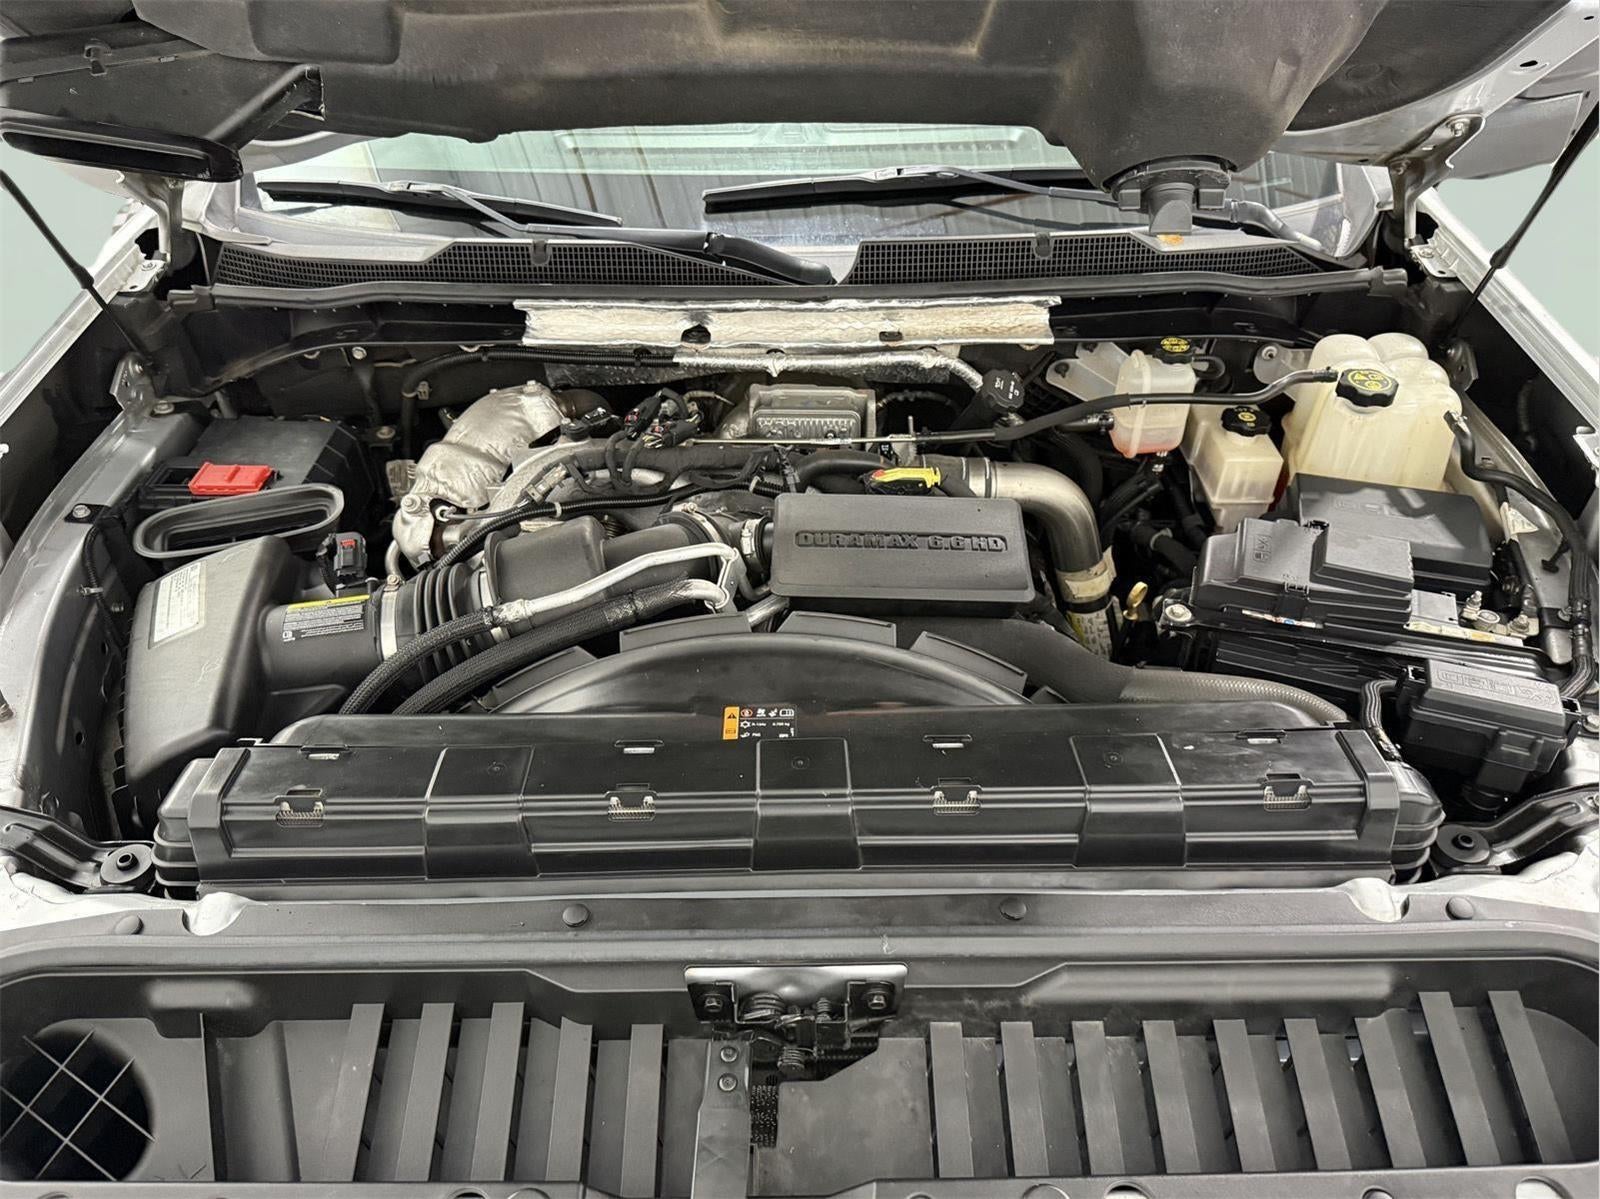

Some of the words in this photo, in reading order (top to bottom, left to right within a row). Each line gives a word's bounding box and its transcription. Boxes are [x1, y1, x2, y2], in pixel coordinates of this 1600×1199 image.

[799, 531, 918, 549] DURAMAX
[927, 533, 965, 550] 6.6
[970, 535, 1006, 551] HD
